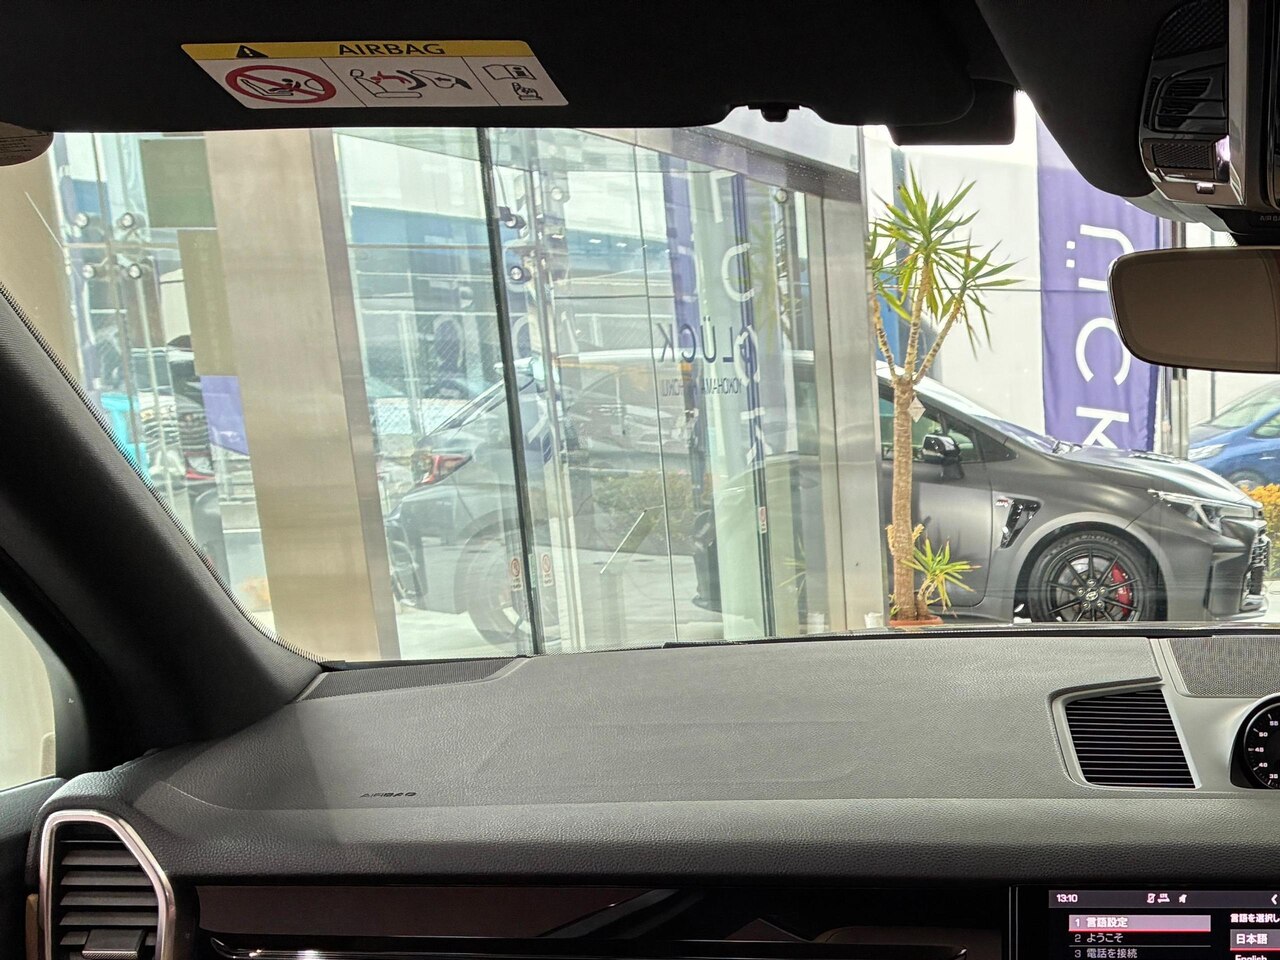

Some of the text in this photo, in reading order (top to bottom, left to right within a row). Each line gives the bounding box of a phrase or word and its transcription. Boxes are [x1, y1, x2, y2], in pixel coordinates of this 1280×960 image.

[338, 44, 446, 56] AIRBAG
[1056, 894, 1078, 903] 13:10
[1075, 917, 1128, 928] 1 言語設定
[1074, 933, 1124, 943] 2 ようこそ
[1236, 934, 1267, 945] 日本語
[1074, 948, 1138, 958] 3 電話を接続
